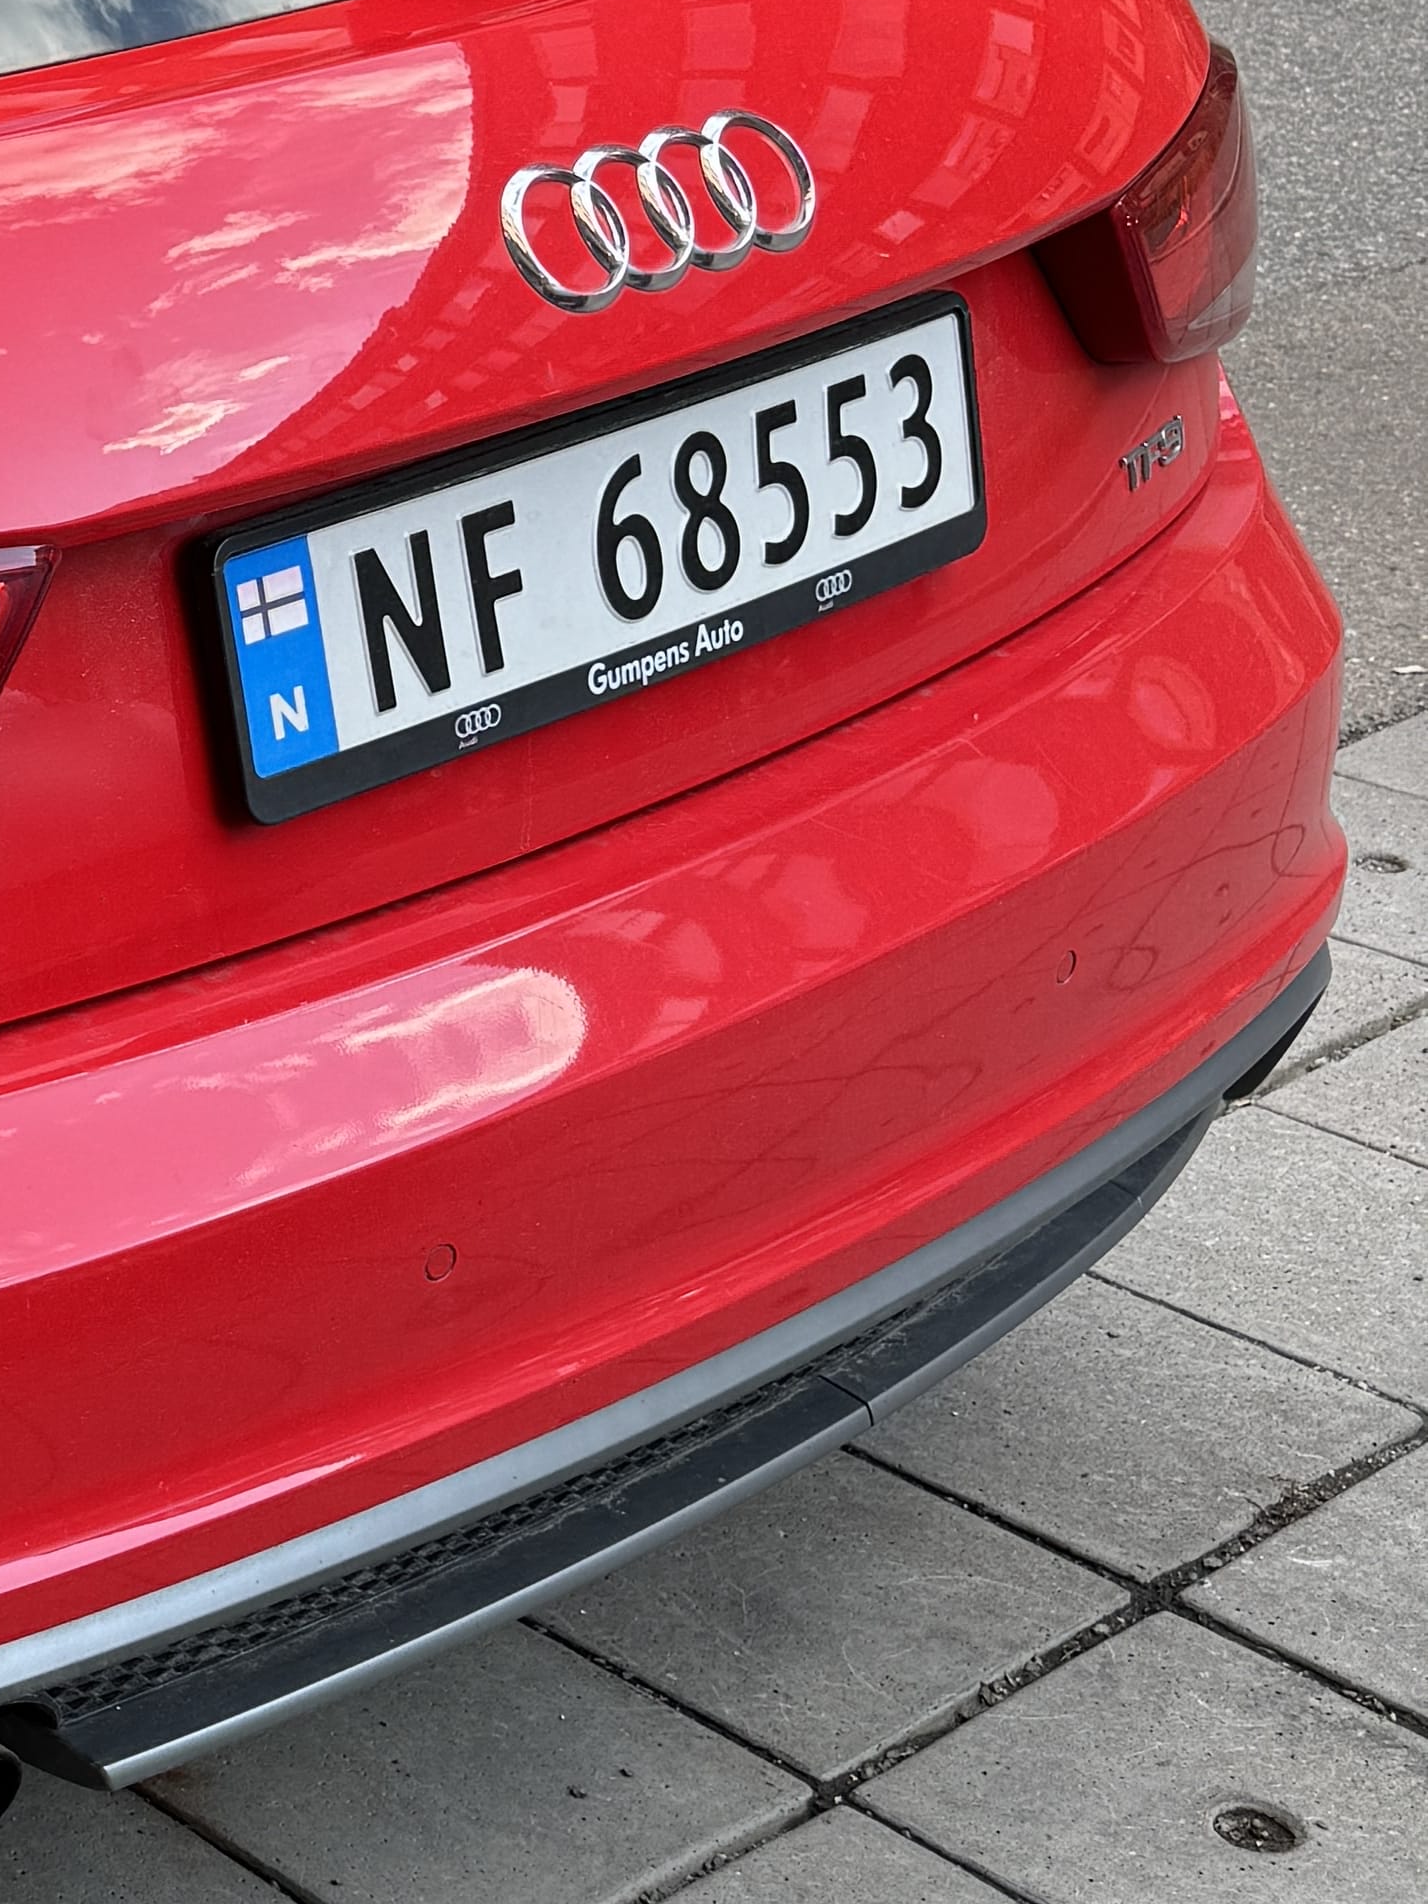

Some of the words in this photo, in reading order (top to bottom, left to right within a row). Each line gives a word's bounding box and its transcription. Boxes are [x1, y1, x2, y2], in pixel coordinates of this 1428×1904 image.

[353, 500, 522, 712] NF
[596, 354, 943, 621] 68553
[588, 642, 690, 695] Gumpens
[695, 619, 744, 657] Auto
[270, 685, 309, 740] N
